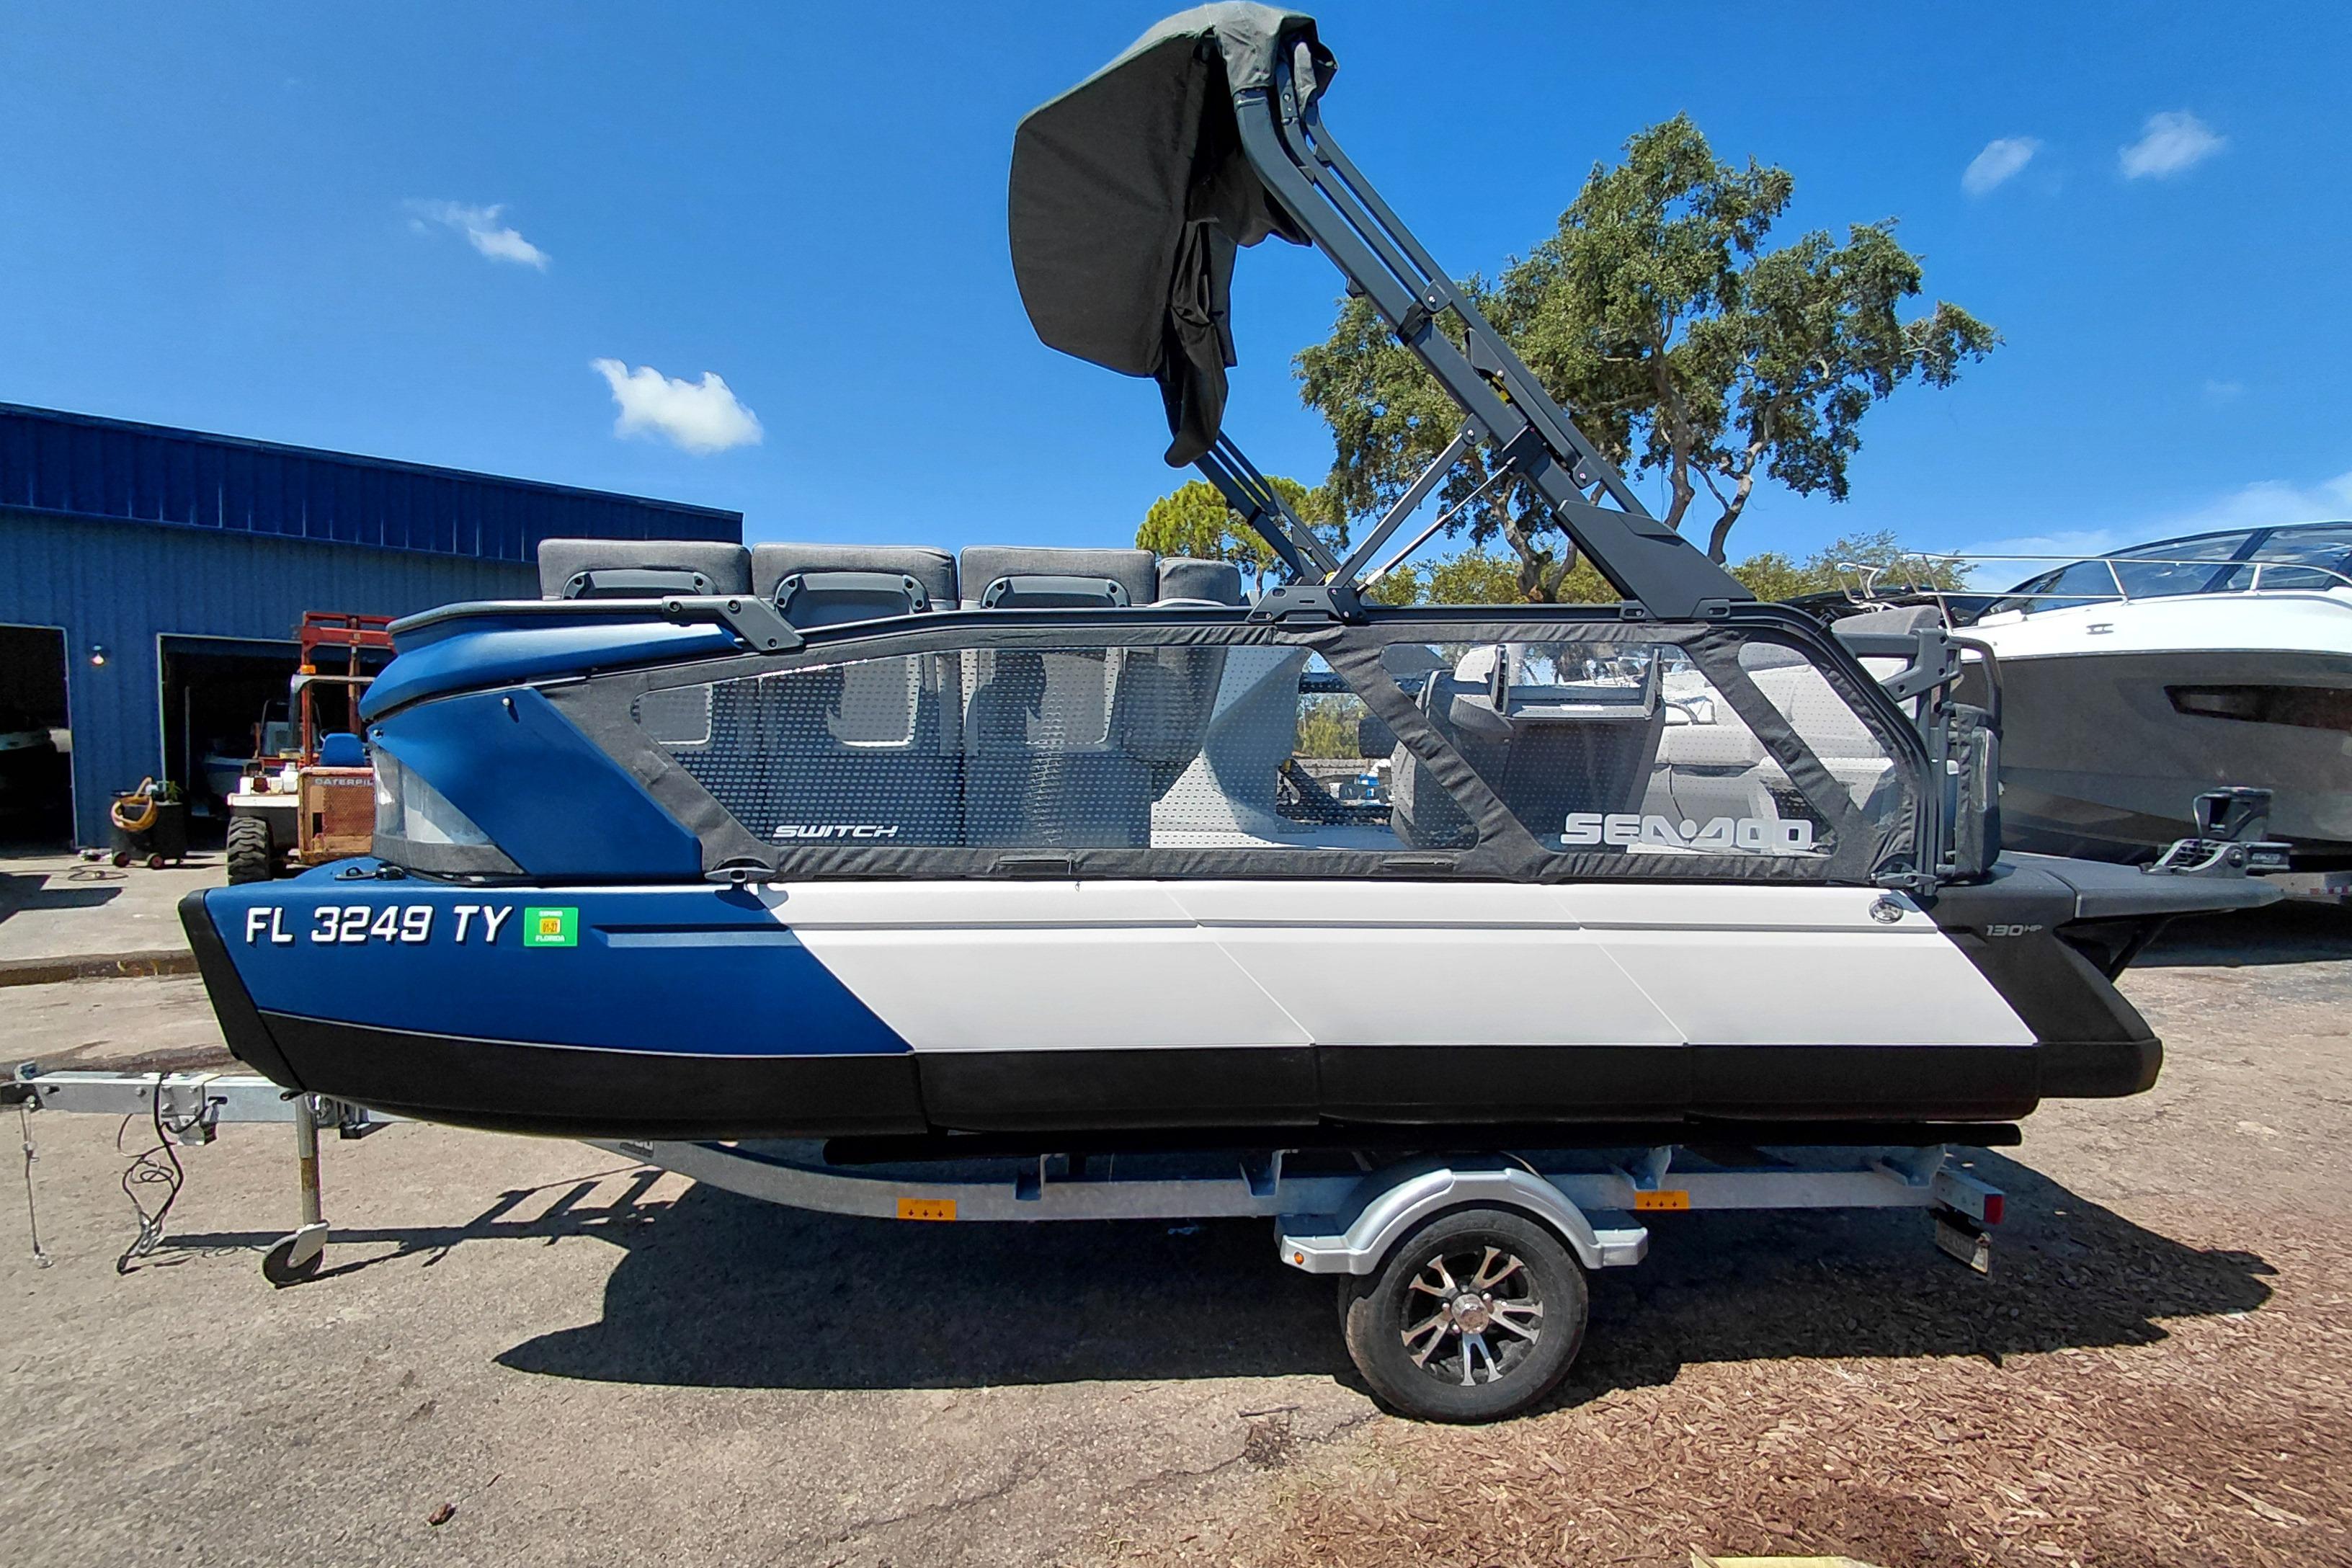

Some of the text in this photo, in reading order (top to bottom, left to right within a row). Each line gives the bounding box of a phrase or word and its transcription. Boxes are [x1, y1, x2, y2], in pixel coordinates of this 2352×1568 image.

[772, 825, 899, 837] SWITCH
[246, 905, 512, 943] FL 3249 TY
